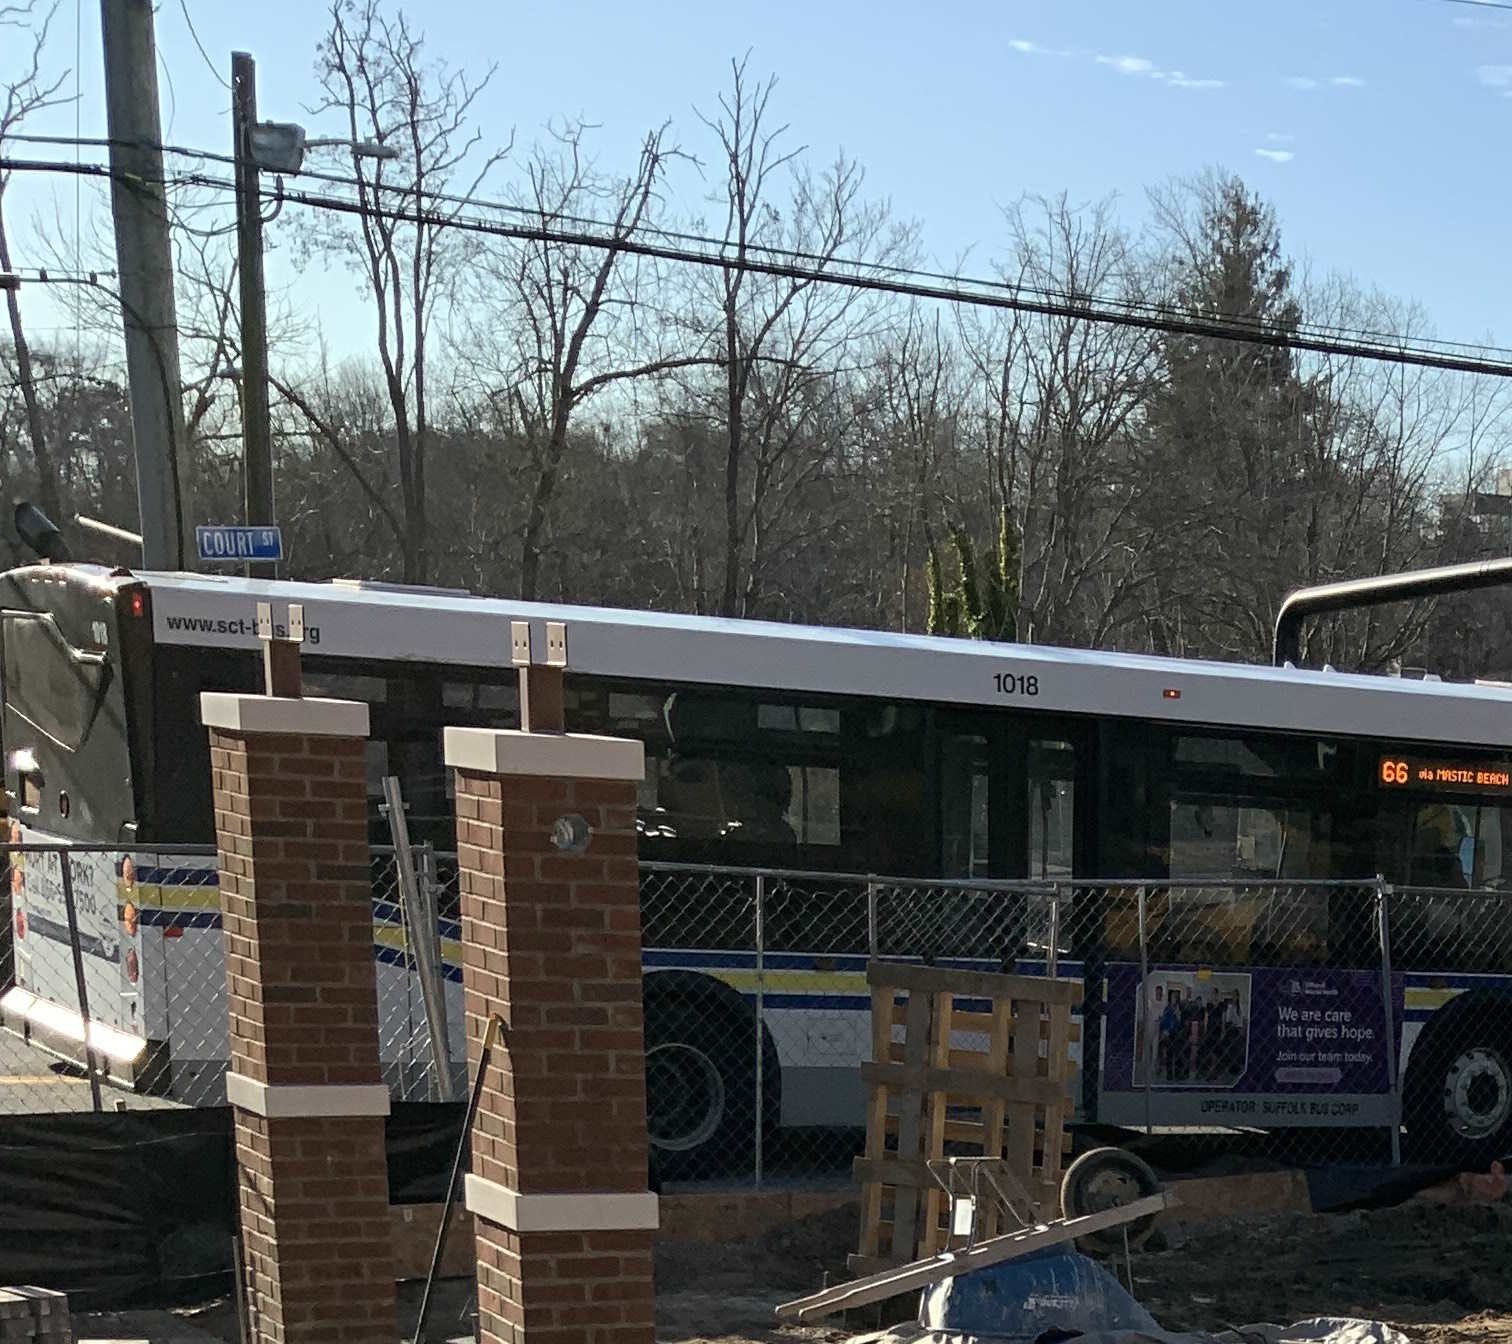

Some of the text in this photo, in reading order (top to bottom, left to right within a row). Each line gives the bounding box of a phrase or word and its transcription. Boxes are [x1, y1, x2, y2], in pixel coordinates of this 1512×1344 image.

[202, 531, 274, 555] COURT ST
[993, 673, 1039, 696] 1018
[1382, 761, 1408, 784] 66
[1436, 768, 1474, 783] MASTIC
[1476, 771, 1509, 786] BEACH
[1279, 1007, 1352, 1022] We are care
[1277, 1024, 1302, 1038] that
[1305, 1025, 1338, 1042] gives
[1276, 1051, 1297, 1061] Join
[1299, 1053, 1316, 1061] our
[1318, 1051, 1343, 1062] team
[1262, 1101, 1307, 1114] SUFFOLK
[1310, 1103, 1329, 1115] BUS
